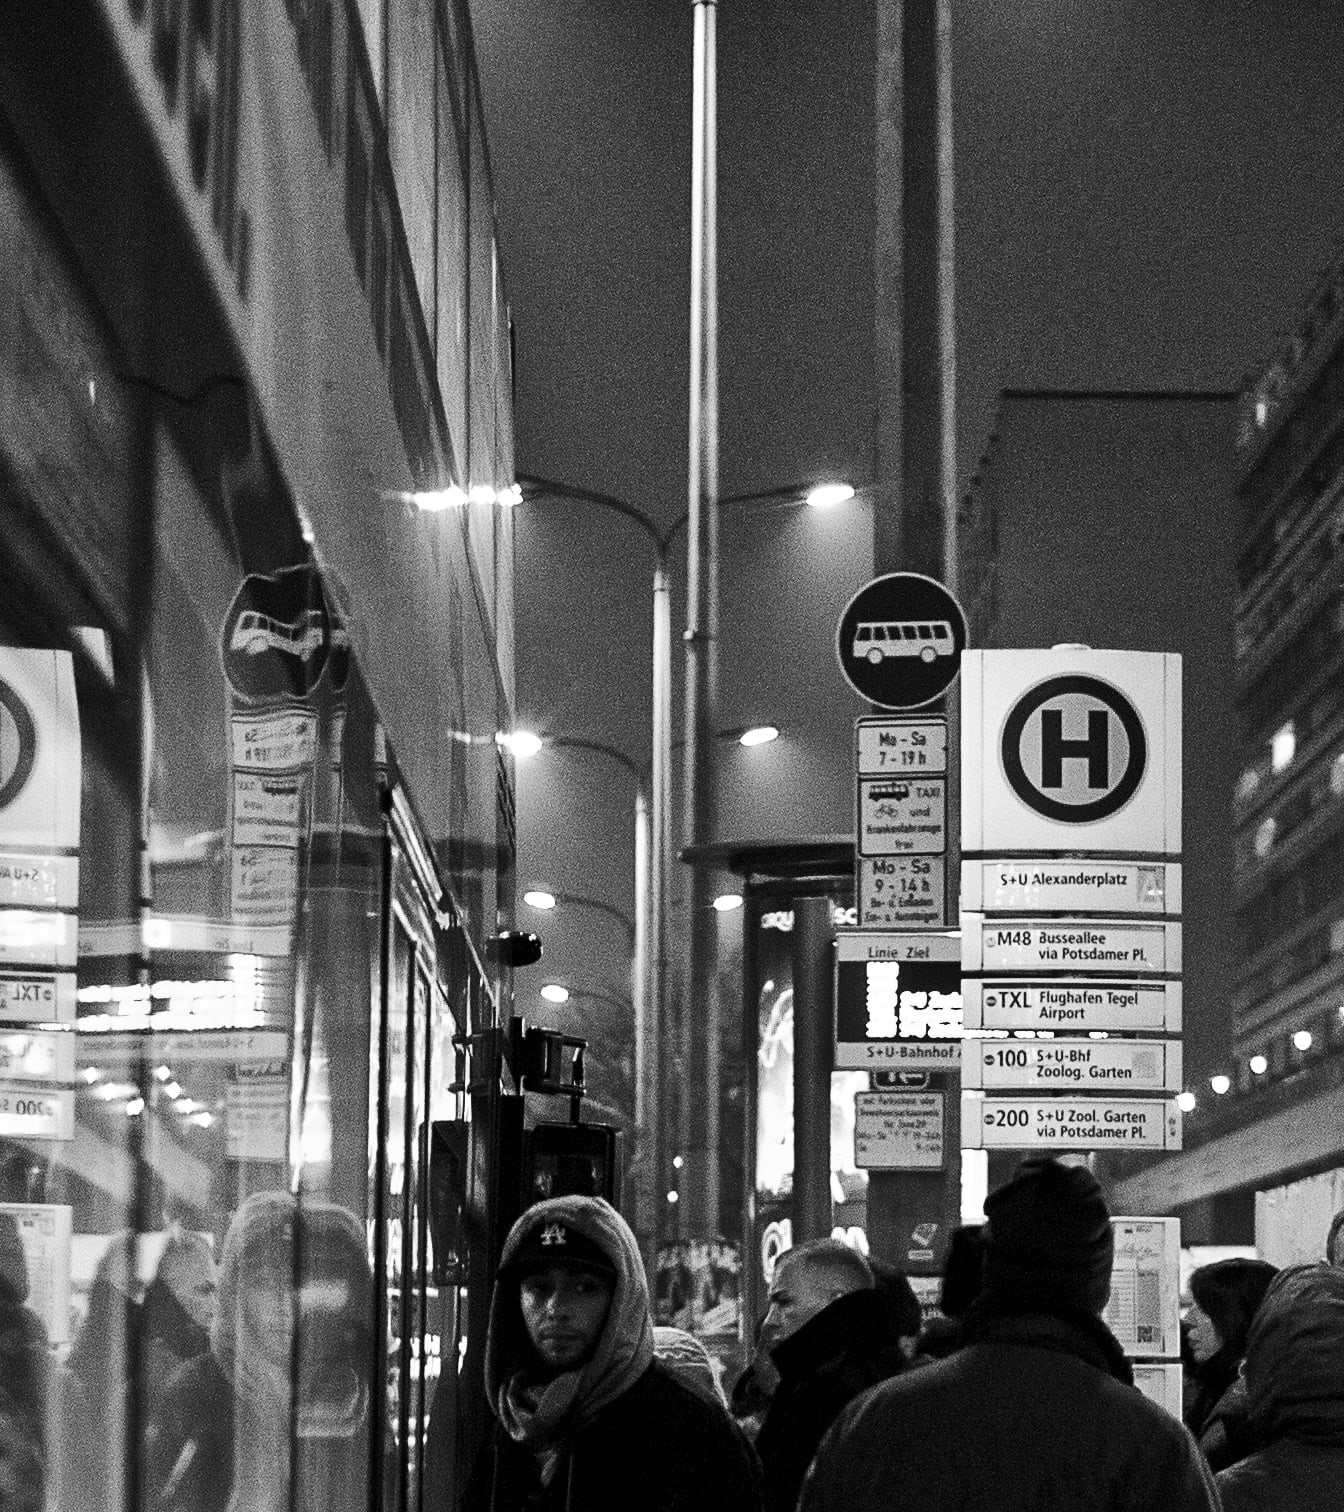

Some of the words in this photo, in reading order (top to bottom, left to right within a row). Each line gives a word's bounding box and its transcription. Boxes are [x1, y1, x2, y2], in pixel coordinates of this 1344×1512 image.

[911, 731, 926, 746] Sa
[1041, 709, 1109, 790] H
[873, 860, 895, 875] Mo
[911, 859, 931, 874] Sa
[1032, 872, 1128, 888] Alexanderplatz
[997, 931, 1032, 947] M48
[868, 946, 899, 959] Linie
[906, 946, 930, 959] Ziel
[1039, 947, 1058, 960] via
[1062, 947, 1129, 961] Potsdamer
[1132, 949, 1147, 962] Pl.
[999, 991, 1032, 1008] TXL
[1040, 991, 1103, 1006] Flughafen
[1106, 992, 1139, 1006] Tegel
[1039, 1008, 1086, 1021] Airport
[997, 1050, 1027, 1067] 100
[1036, 1065, 1085, 1080] Zoolog.
[1089, 1066, 1133, 1079] Garten
[996, 1110, 1029, 1127] 200
[1068, 1110, 1097, 1124] Zool.
[1103, 1110, 1147, 1125] Garten
[1037, 1126, 1056, 1139] via
[1060, 1125, 1128, 1139] Potsdamer
[1131, 1126, 1147, 1139] Pl.
